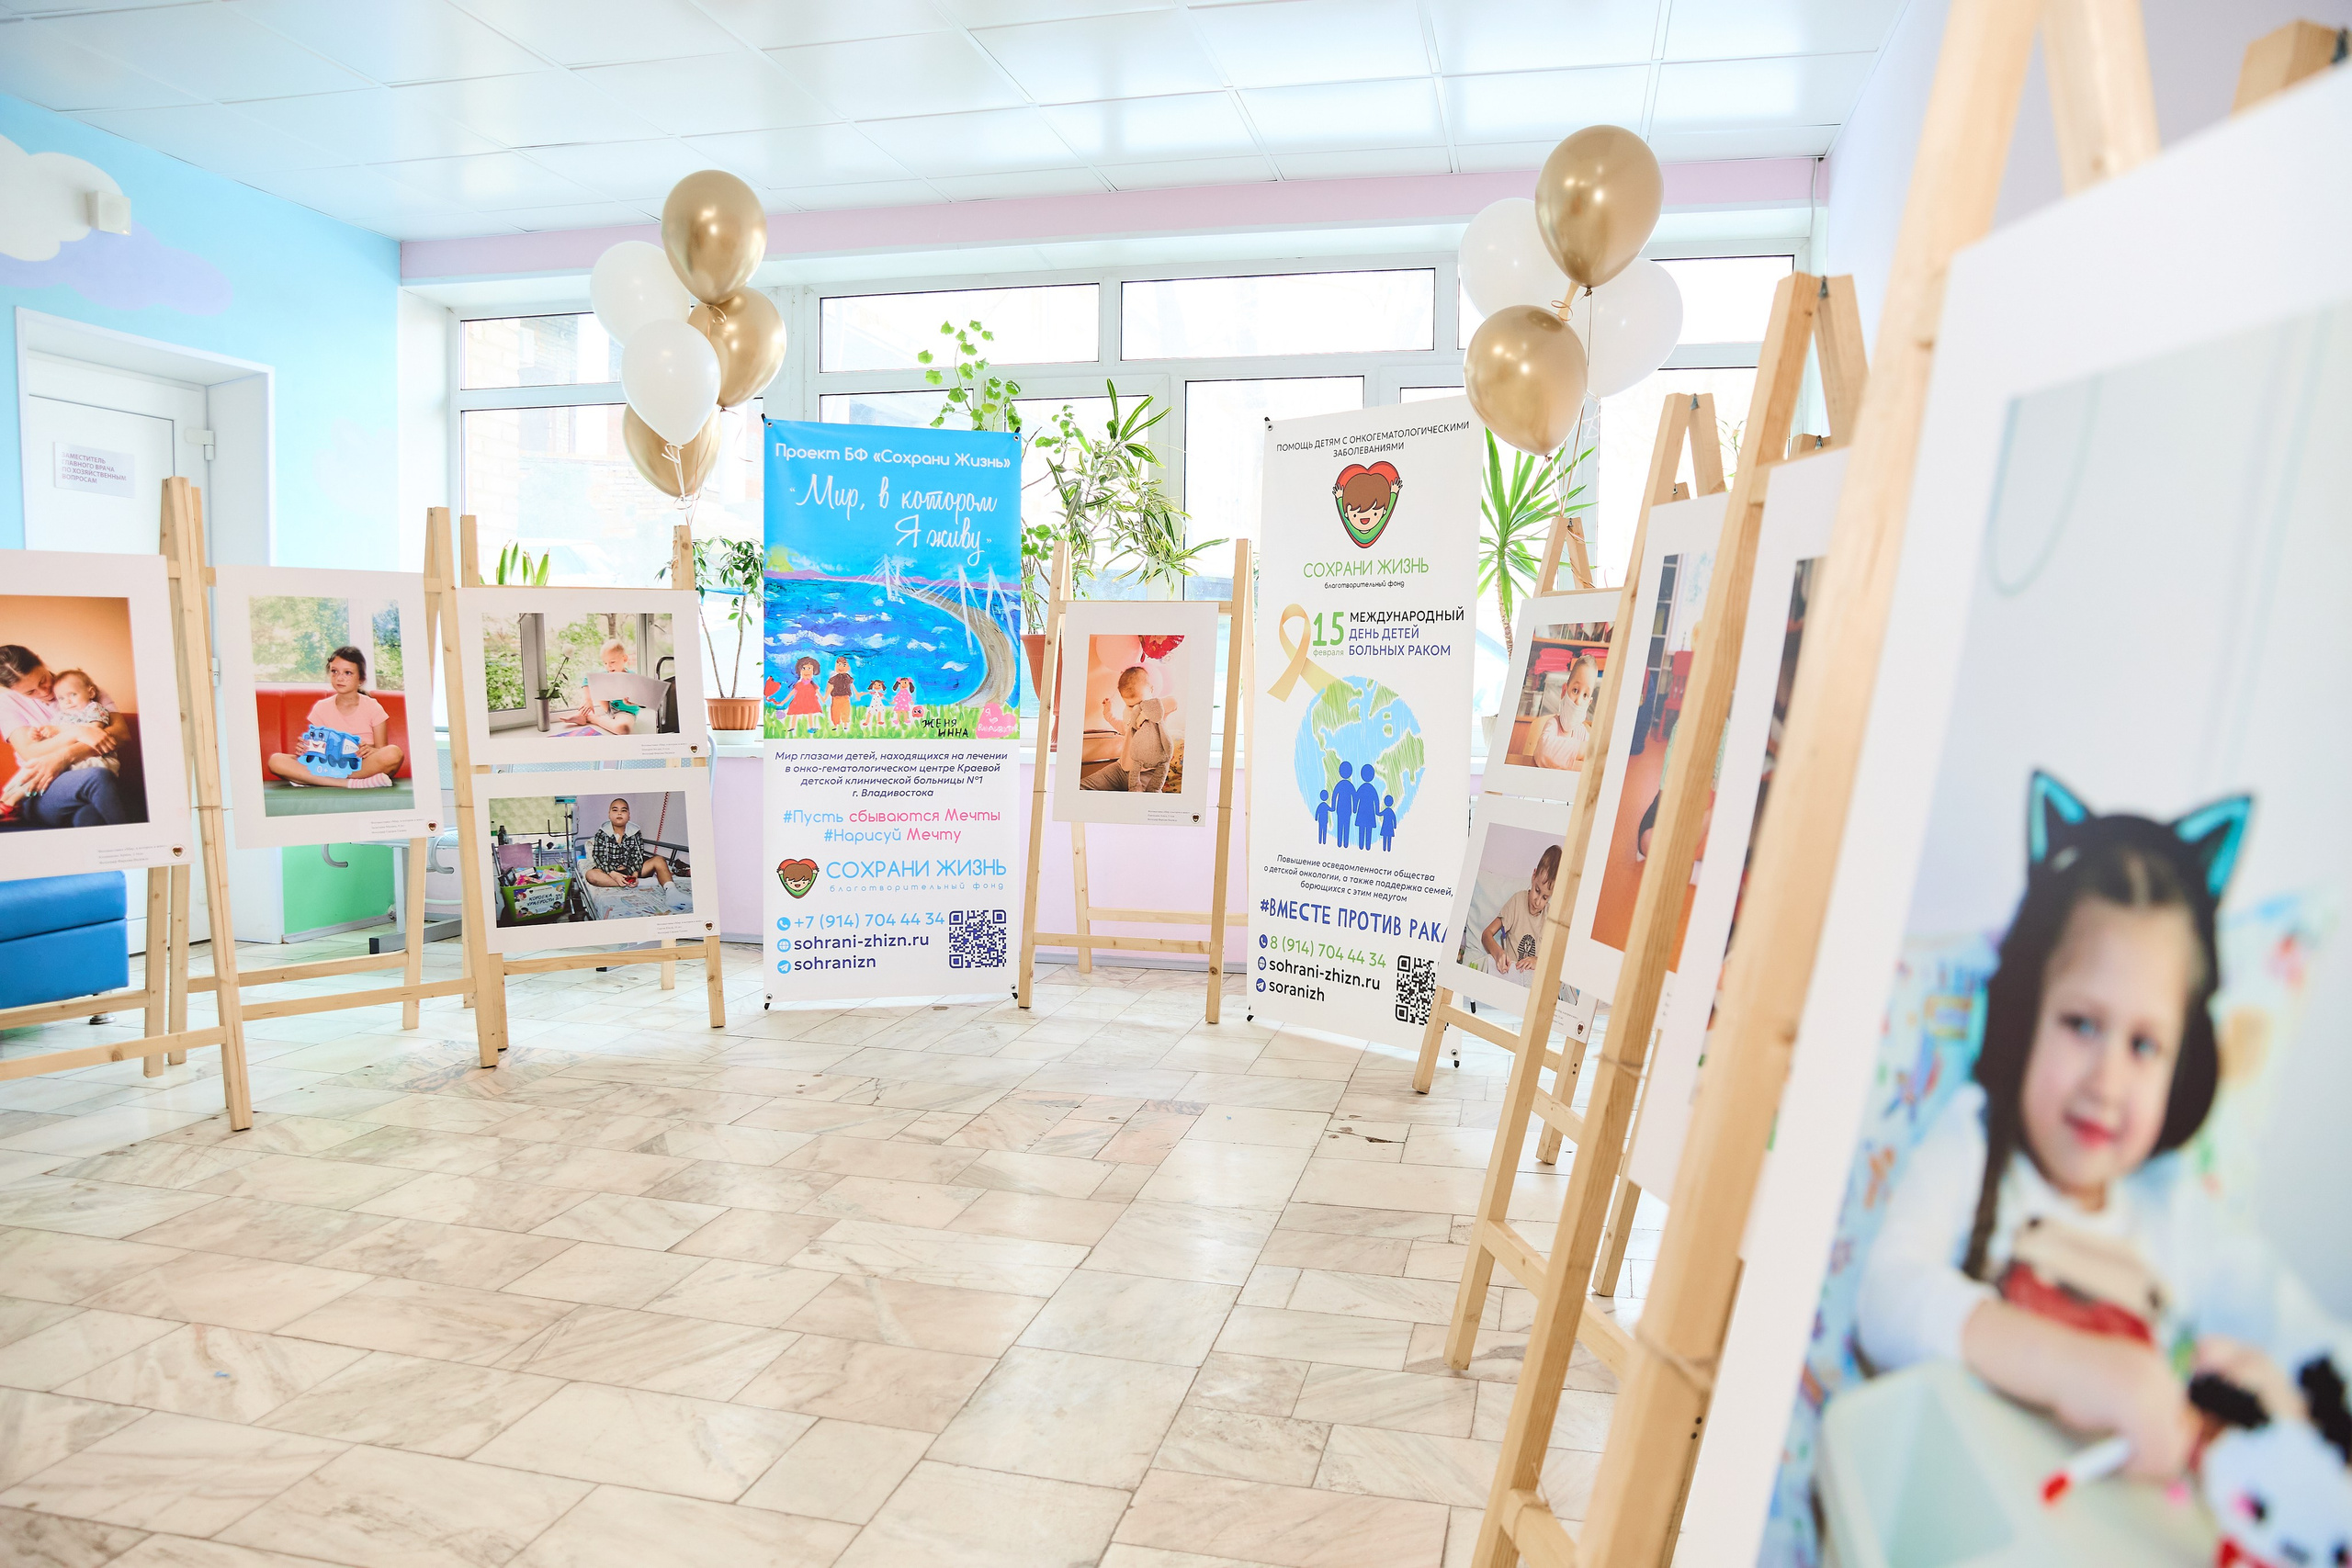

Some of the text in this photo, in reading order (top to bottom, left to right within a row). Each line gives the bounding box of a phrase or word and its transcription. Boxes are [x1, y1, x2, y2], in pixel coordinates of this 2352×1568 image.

[1276, 421, 1470, 452] ПОМОЩЬ ДЕТЯМ С ОНКОГЕМАТОЛОГИЧЕСКИМИ
[62, 452, 106, 464] ЗАМЕСТИТЕЛЬ
[775, 443, 1011, 468] Проект БФ «Сохрани Жизнь»
[1332, 442, 1405, 457] ЗАБОЛЕВАНИЯМИ
[62, 459, 115, 472] ГЛАВНОГО ВРАЧА
[73, 467, 127, 480] ХОЗЯЙСТВЕННЫМ
[62, 473, 97, 483] ВОПРОСАМ
[879, 476, 889, 509] в
[901, 490, 998, 525] котором
[895, 514, 922, 548] Я
[1303, 557, 1430, 578] СОХРАНИ ЖИЗНЬ
[1324, 580, 1405, 590] благотворительный фонд
[1312, 606, 1464, 647] 15 МЕЖДУНАРОДНЫЙ
[1349, 625, 1419, 641] ДЕНЬ ДЕТЕЙ
[1313, 648, 1344, 657] февраля
[1349, 644, 1451, 656] БОЛЬНЫХ РАКОМ
[922, 718, 957, 728] ЖЕНЯ
[938, 728, 969, 738] ИННА
[775, 750, 1008, 763] Мир глазами детей, находящихся на лечении
[793, 764, 917, 773] онко-гематологическом
[919, 764, 956, 773] центре
[957, 762, 1001, 773] Краевой
[800, 775, 842, 786] детской
[844, 774, 911, 784] клинической
[913, 774, 964, 786] больницы
[852, 788, 934, 798] г. Владивостока
[783, 808, 1001, 827] #Пусть сбываются Мечты
[824, 828, 961, 845] #Нарисуй Мечту
[827, 858, 1007, 879] СОХРАНИ ЖИЗНЬ
[1276, 854, 1435, 882] Повышение осведомленности общества
[830, 881, 1004, 893] благотворительный фонд
[1269, 864, 1297, 875] детской
[1299, 870, 1341, 882] онкологии,
[1350, 876, 1374, 886] также
[1375, 879, 1422, 893] поддержка
[1424, 886, 1453, 897] семей,
[1300, 881, 1345, 894] борющихся
[1352, 888, 1372, 897] этим
[1373, 892, 1408, 903] недугом
[794, 912, 944, 931] +7 (914) 704 44 34
[1260, 897, 1330, 925] #ВМЕСТЕ
[1337, 908, 1401, 936] ПРОТИВ
[794, 933, 930, 950] sohrani-zhizn.ru
[1270, 935, 1386, 968] 8 (914) 704 44 34
[794, 955, 876, 971] sohranizn
[1269, 959, 1381, 990] sohrani-zhizn.ru
[1269, 980, 1325, 1002] soranizh
